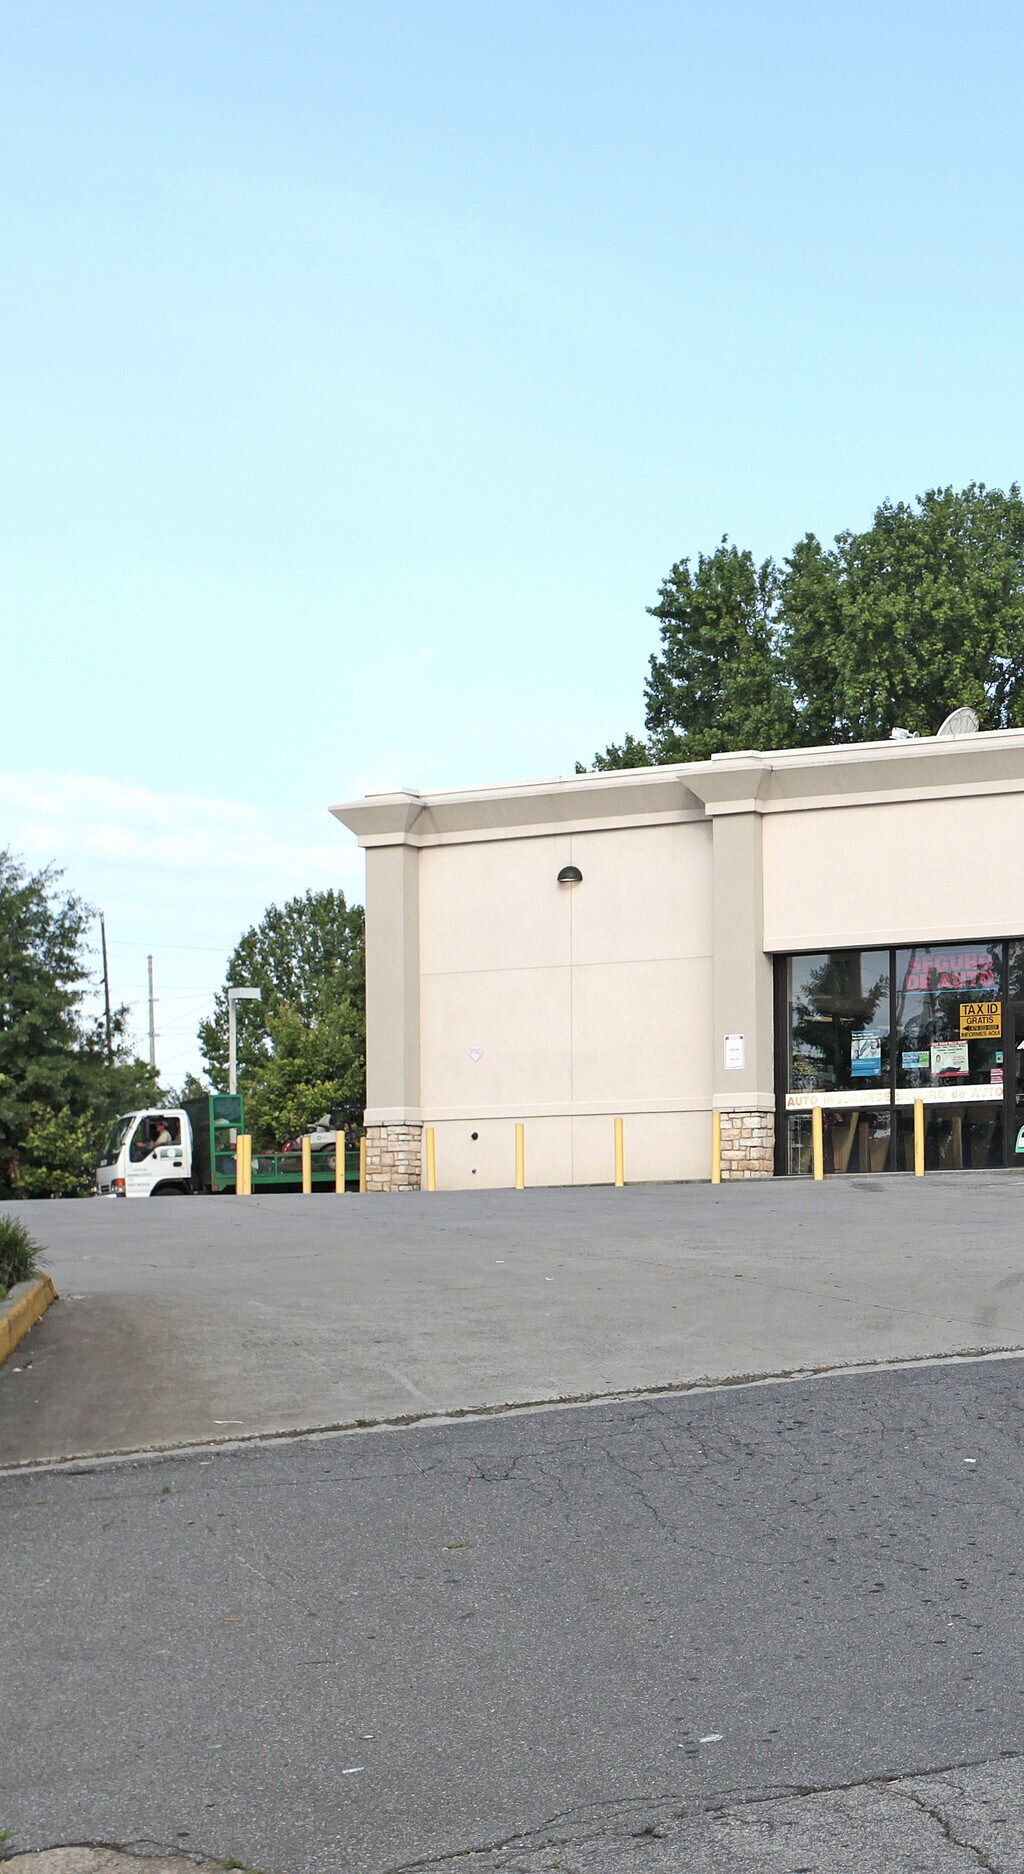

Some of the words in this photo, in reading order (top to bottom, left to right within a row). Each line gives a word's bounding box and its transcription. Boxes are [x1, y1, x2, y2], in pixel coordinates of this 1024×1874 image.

[909, 952, 993, 973] SEGURO
[905, 972, 932, 991] DE
[938, 969, 996, 989] AUTO
[962, 1004, 984, 1015] TAX
[987, 1003, 998, 1014] ID
[787, 1095, 817, 1107] AUTO
[823, 1091, 891, 1104] INSURANCE
[951, 1089, 966, 1099] de
[971, 1087, 1004, 1098] AUTO
